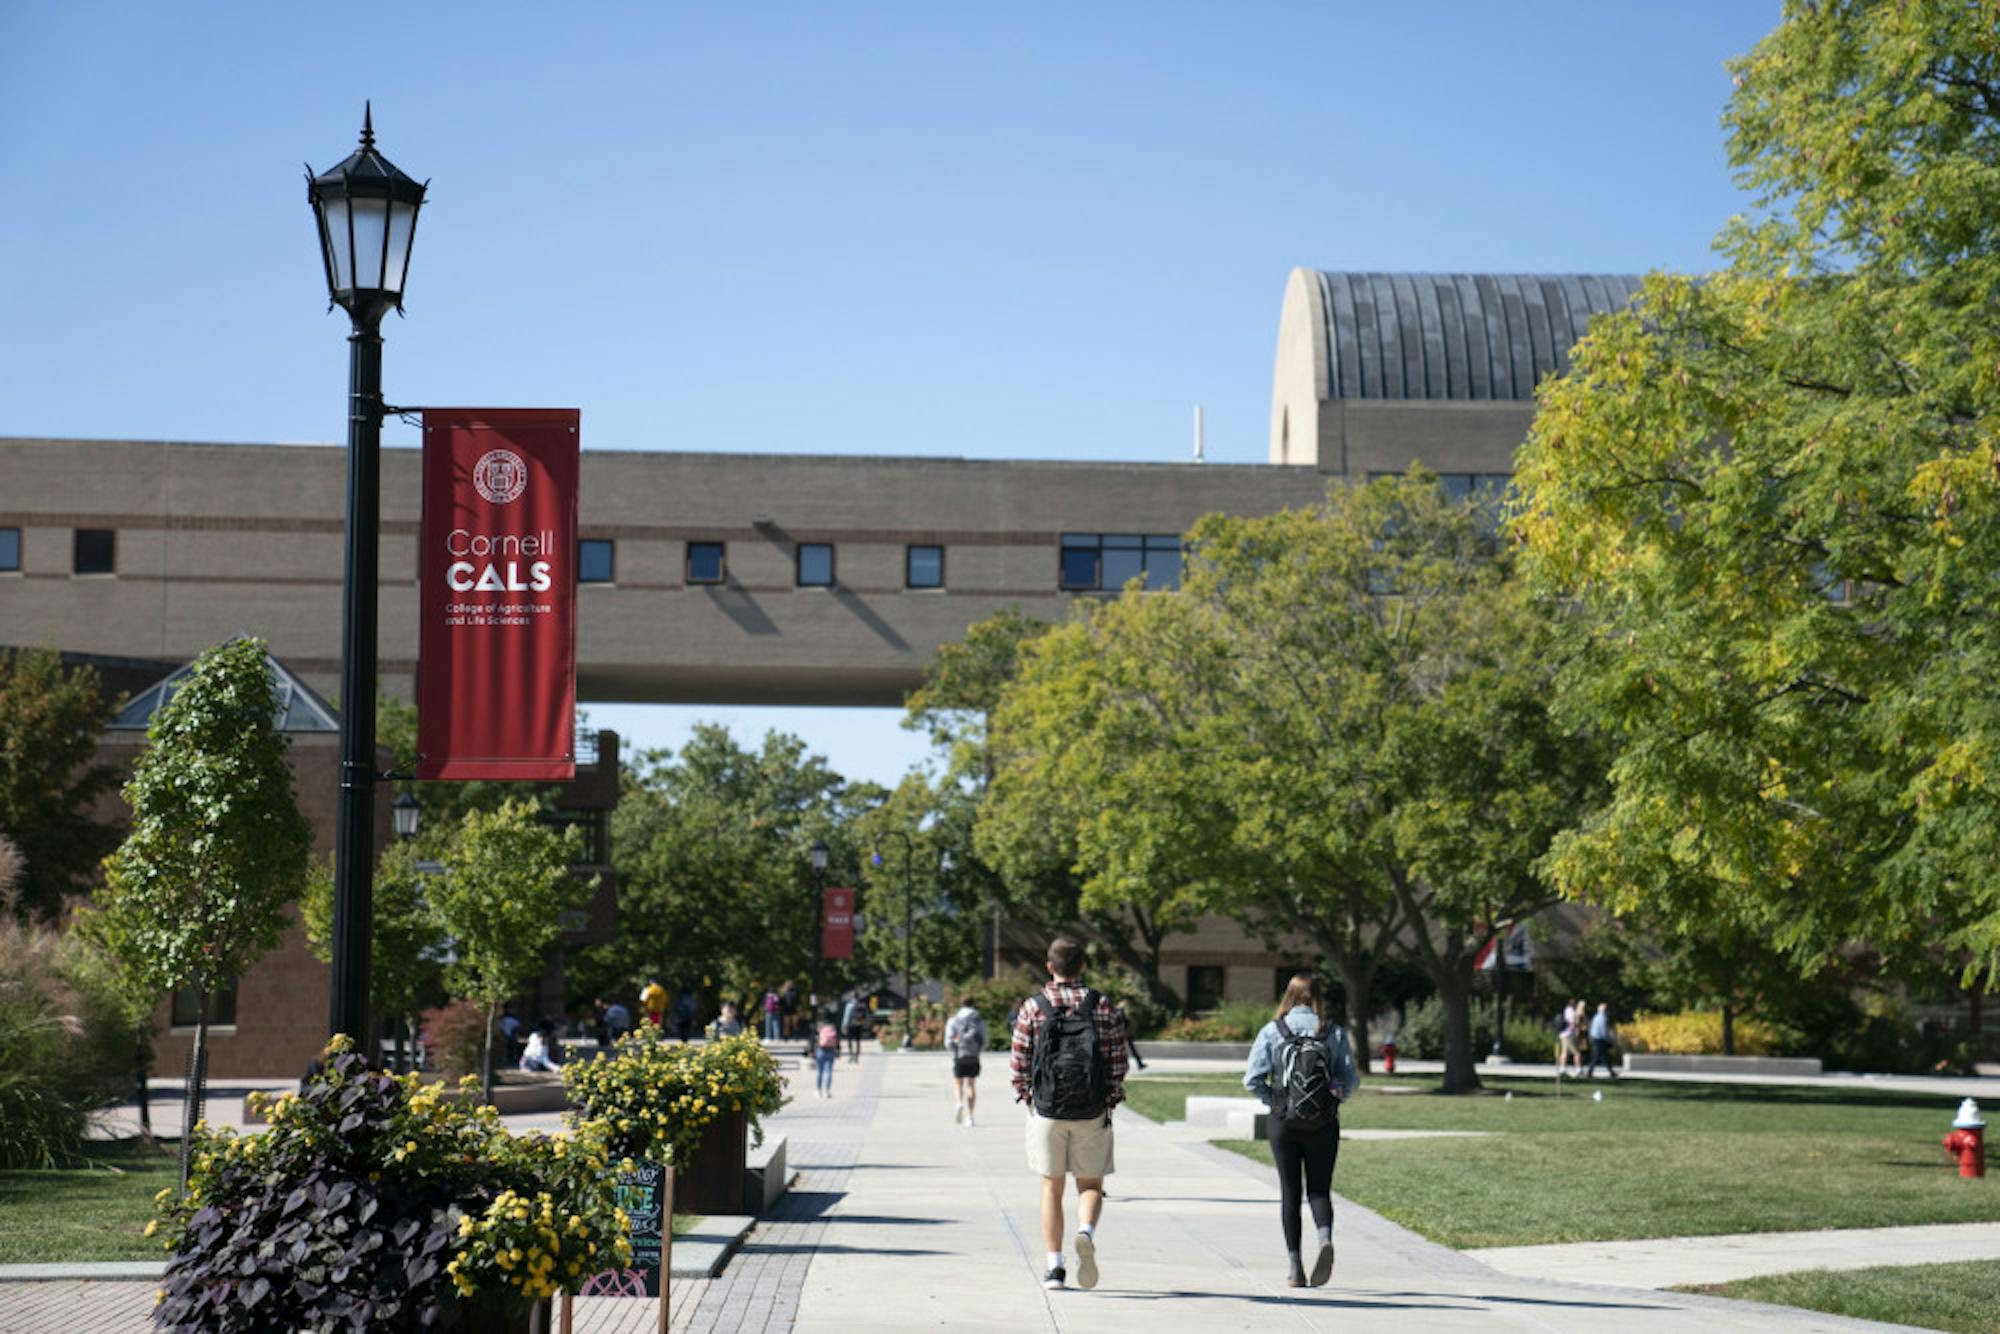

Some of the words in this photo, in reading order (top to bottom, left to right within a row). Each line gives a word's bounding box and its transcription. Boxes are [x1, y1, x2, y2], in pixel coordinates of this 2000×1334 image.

[447, 528, 554, 557] Cornell
[446, 560, 552, 593] CALS
[446, 603, 483, 615] College
[485, 603, 498, 614] of
[499, 603, 552, 615] Agriculture
[446, 616, 466, 625] and
[467, 616, 485, 625] Life
[487, 616, 530, 625] Sciences
